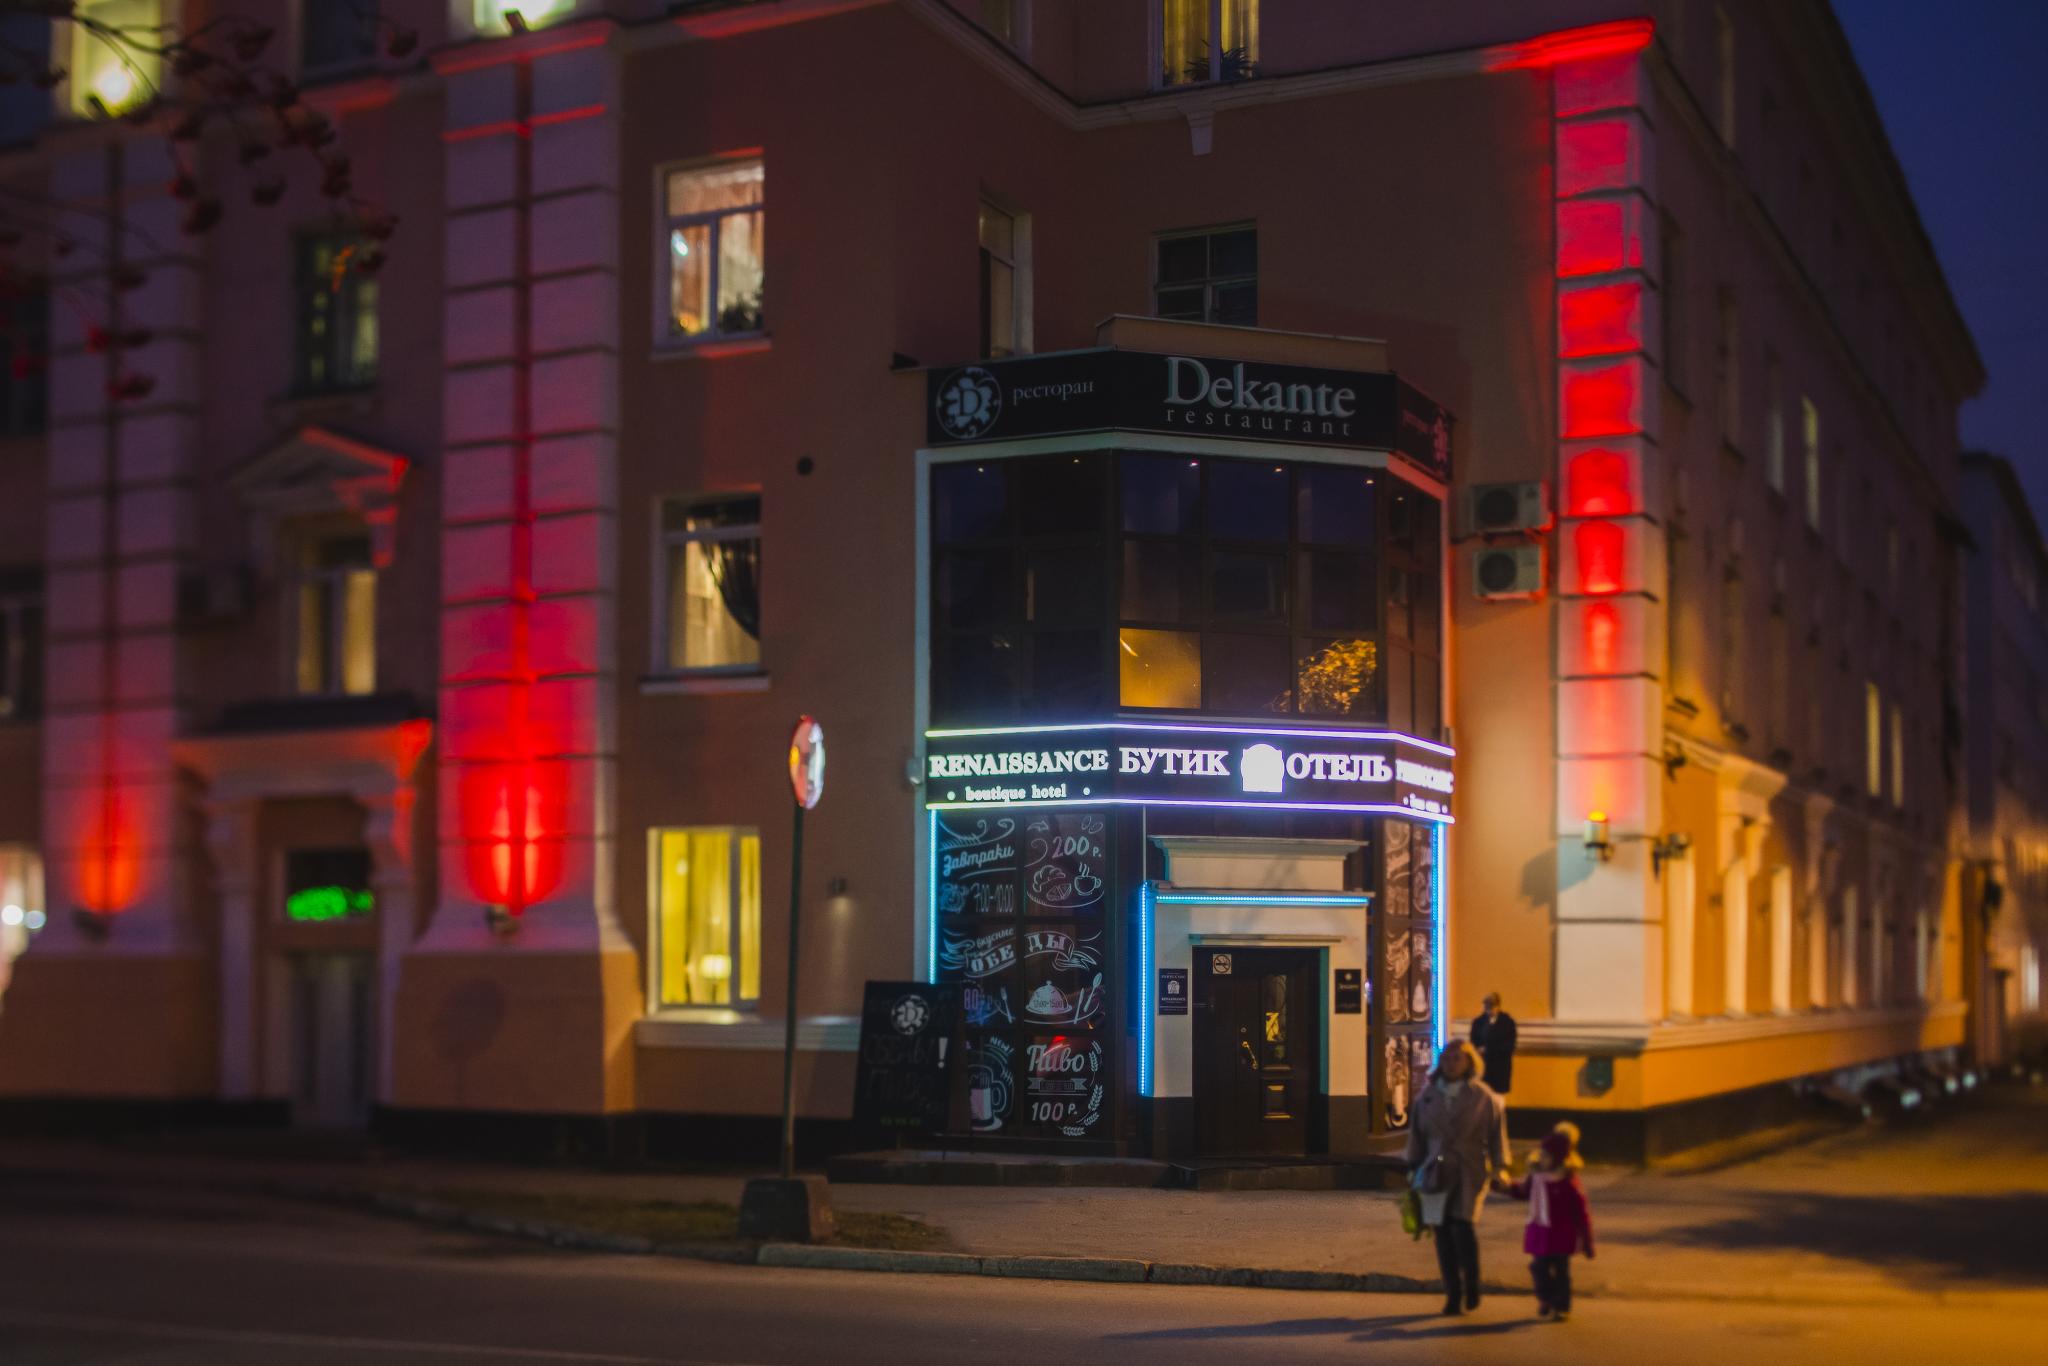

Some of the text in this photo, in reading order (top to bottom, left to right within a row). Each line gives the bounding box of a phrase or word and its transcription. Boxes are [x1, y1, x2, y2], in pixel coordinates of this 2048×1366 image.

[1012, 380, 1094, 406] ресторан
[1163, 356, 1356, 419] Dekante
[1165, 408, 1352, 436] restaurant
[929, 749, 1110, 777] RENAISSANCE
[1119, 747, 1230, 776] БУТИК
[1286, 753, 1394, 782] ОТЕЛЬ
[965, 783, 1067, 803] boutique hotel
[943, 844, 1015, 876] Завтраки
[1052, 836, 1090, 859] 200
[1027, 1044, 1085, 1073] Пиво
[1032, 1102, 1064, 1122] 100
